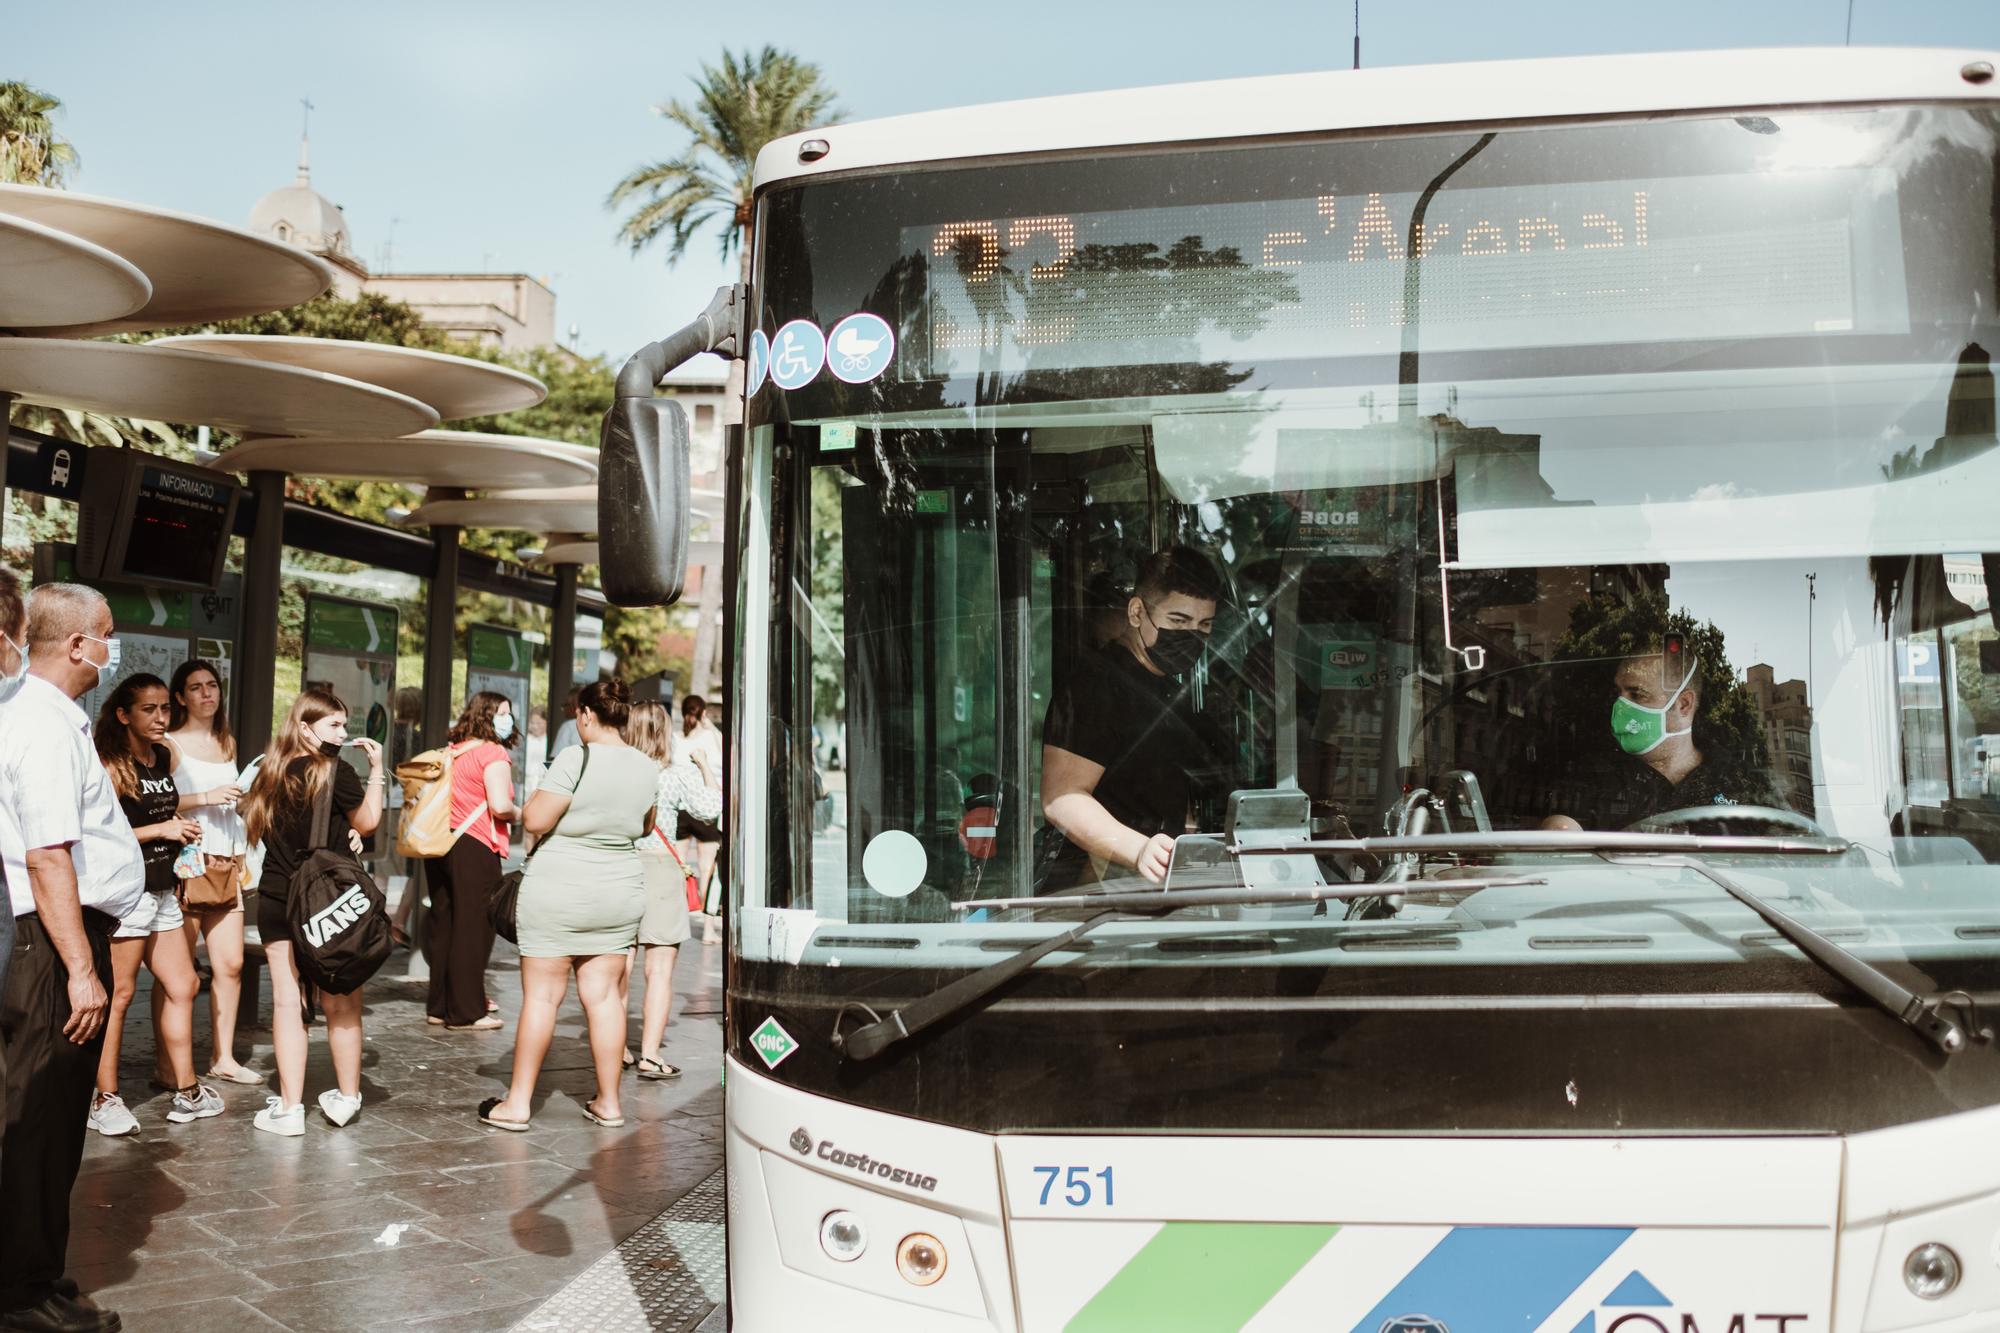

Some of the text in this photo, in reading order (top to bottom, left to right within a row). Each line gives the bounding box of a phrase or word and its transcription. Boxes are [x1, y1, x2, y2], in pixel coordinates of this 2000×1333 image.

[1908, 645, 1930, 677] P
[140, 777, 174, 795] NYC
[301, 883, 372, 948] VANS
[757, 1032, 786, 1052] GNC
[816, 1140, 939, 1192] Castrosua
[1032, 1165, 1114, 1207] 751
